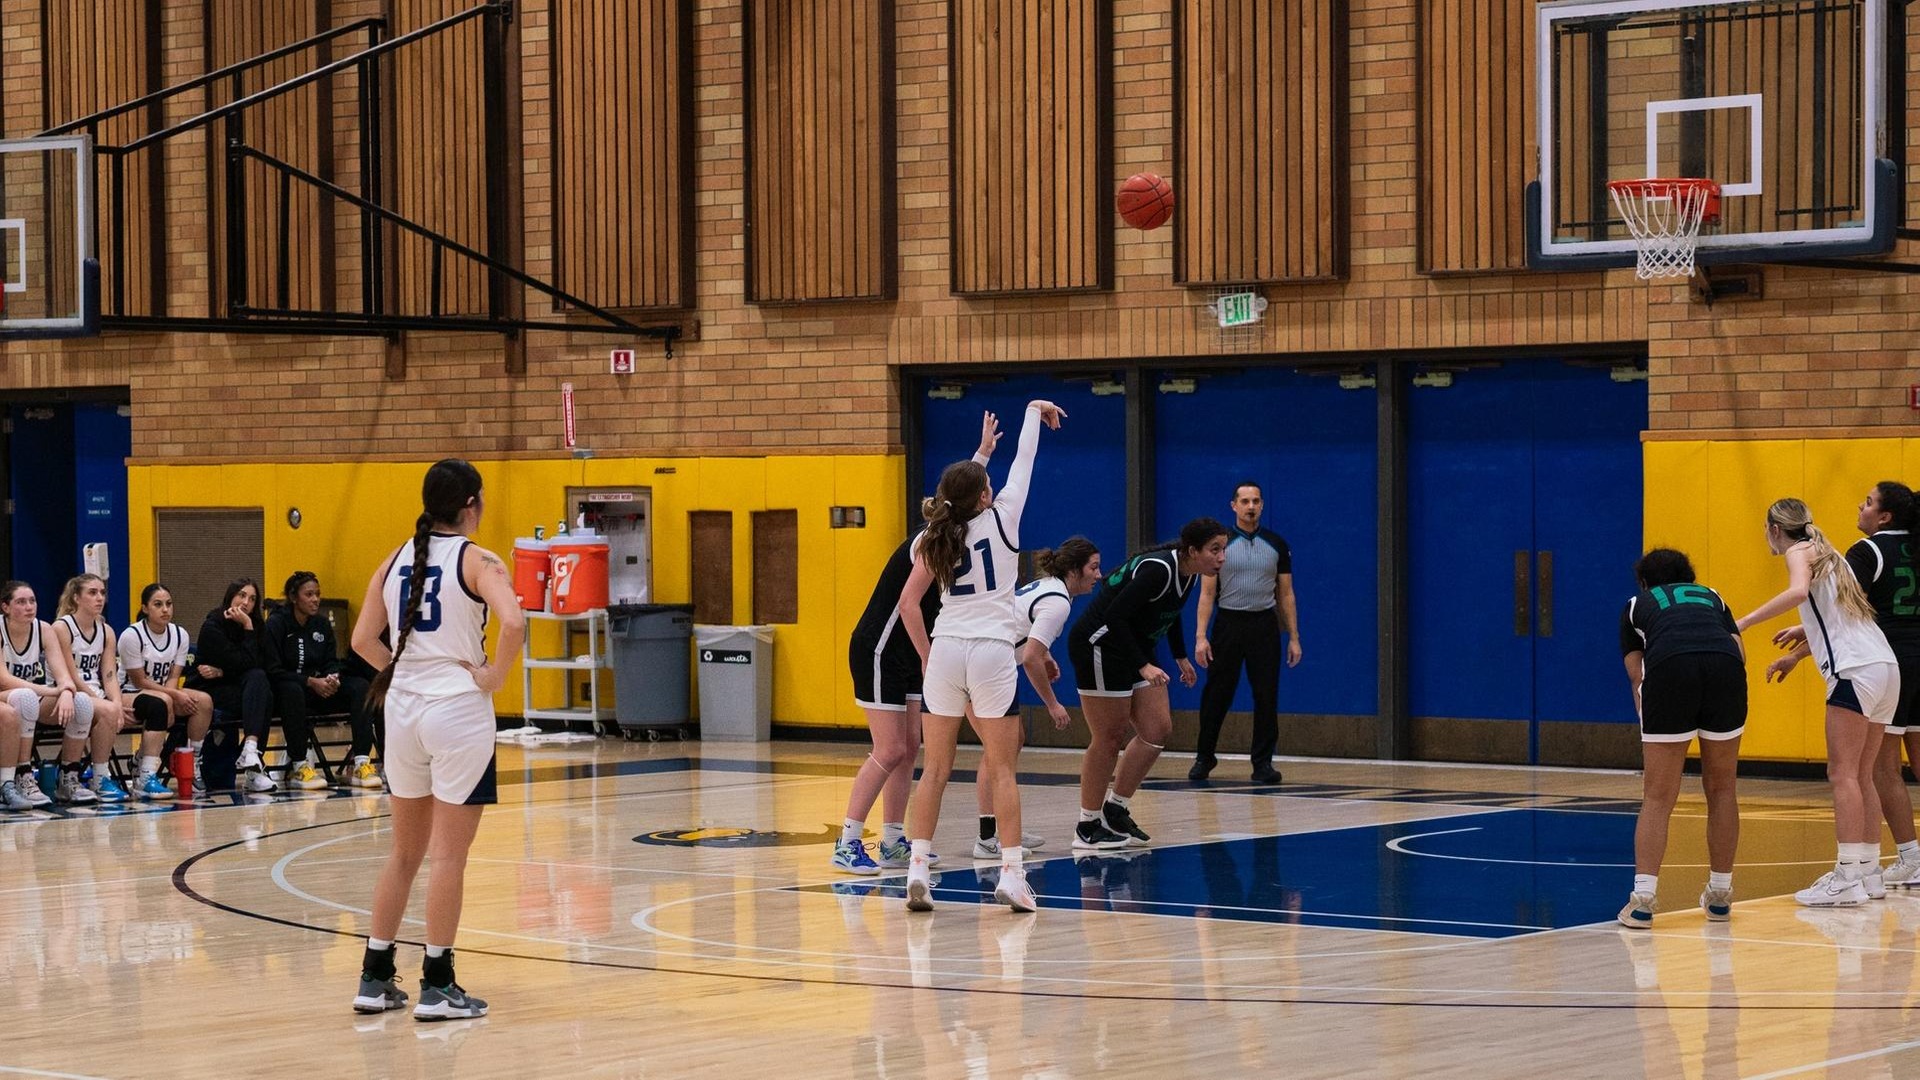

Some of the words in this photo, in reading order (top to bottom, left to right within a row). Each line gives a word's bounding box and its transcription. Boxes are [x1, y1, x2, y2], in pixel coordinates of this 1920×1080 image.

[1224, 294, 1251, 323] EXIT
[949, 538, 997, 596] 21
[1893, 567, 1920, 615] 2
[398, 565, 443, 632] 13
